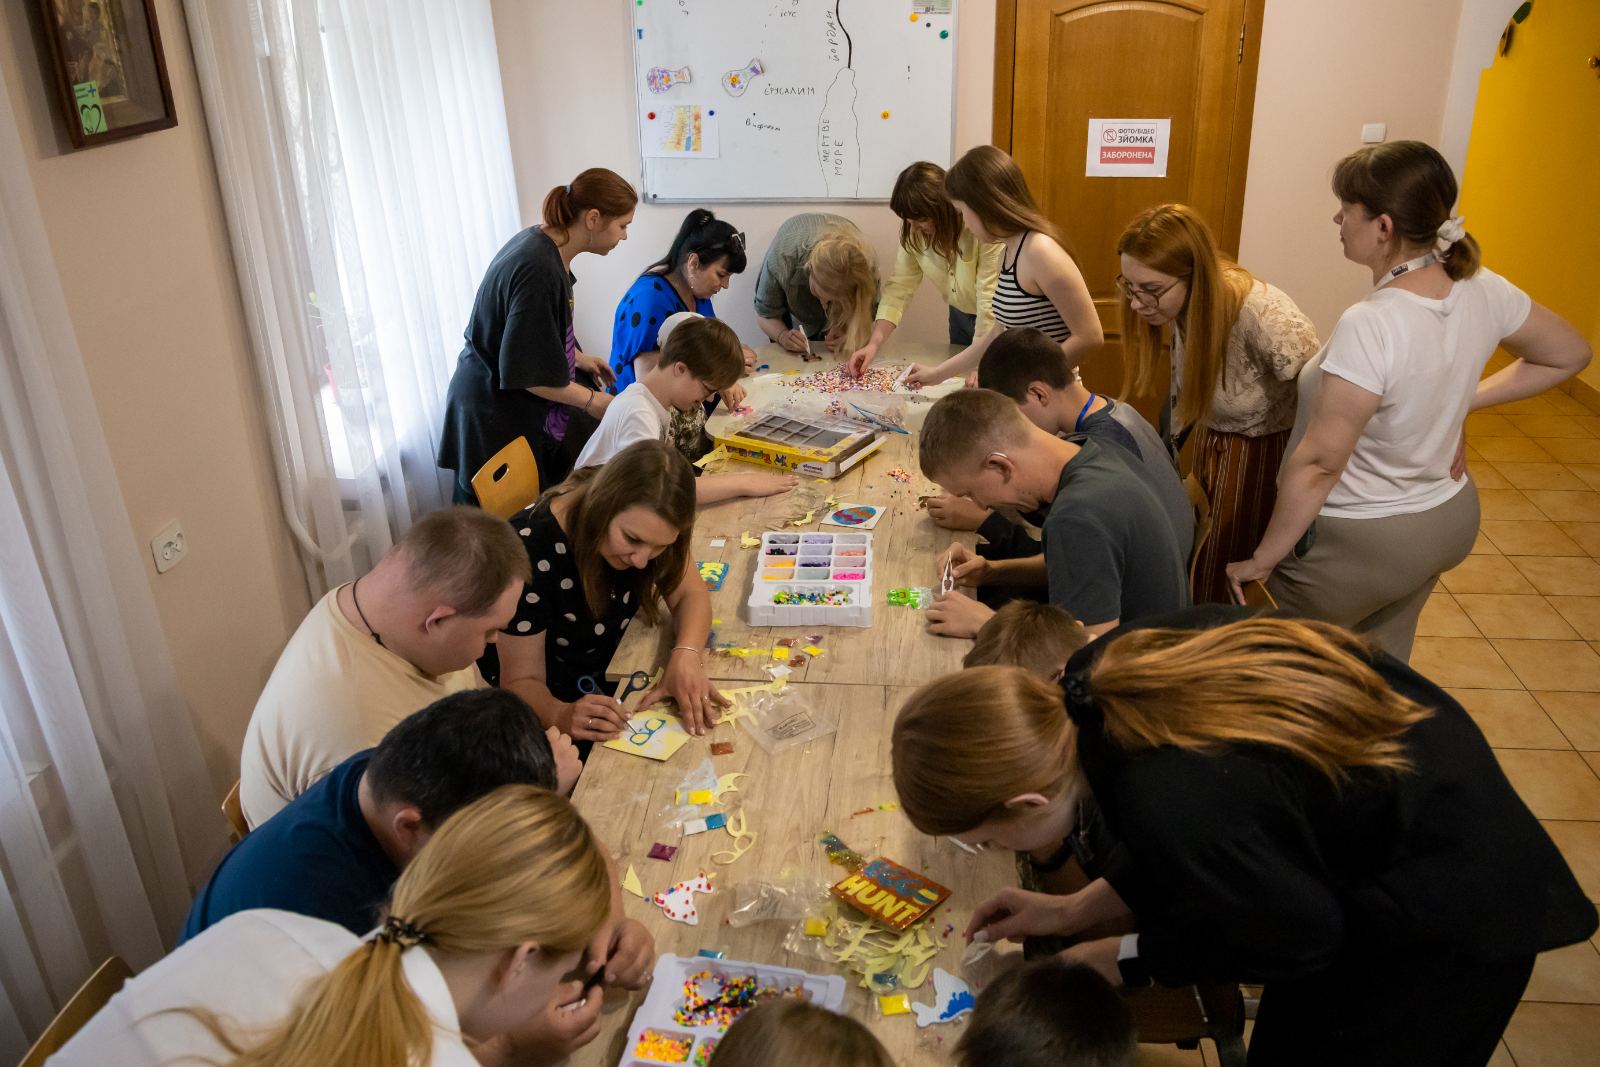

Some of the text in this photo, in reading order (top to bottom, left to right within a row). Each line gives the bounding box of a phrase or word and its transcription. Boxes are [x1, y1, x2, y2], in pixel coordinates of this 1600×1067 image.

[1118, 135, 1154, 144] ЗЙОМКА
[834, 139, 844, 176] МОРЕ
[1101, 151, 1153, 159] ЗАБОРОНЕНА
[837, 874, 922, 922] HUNT
